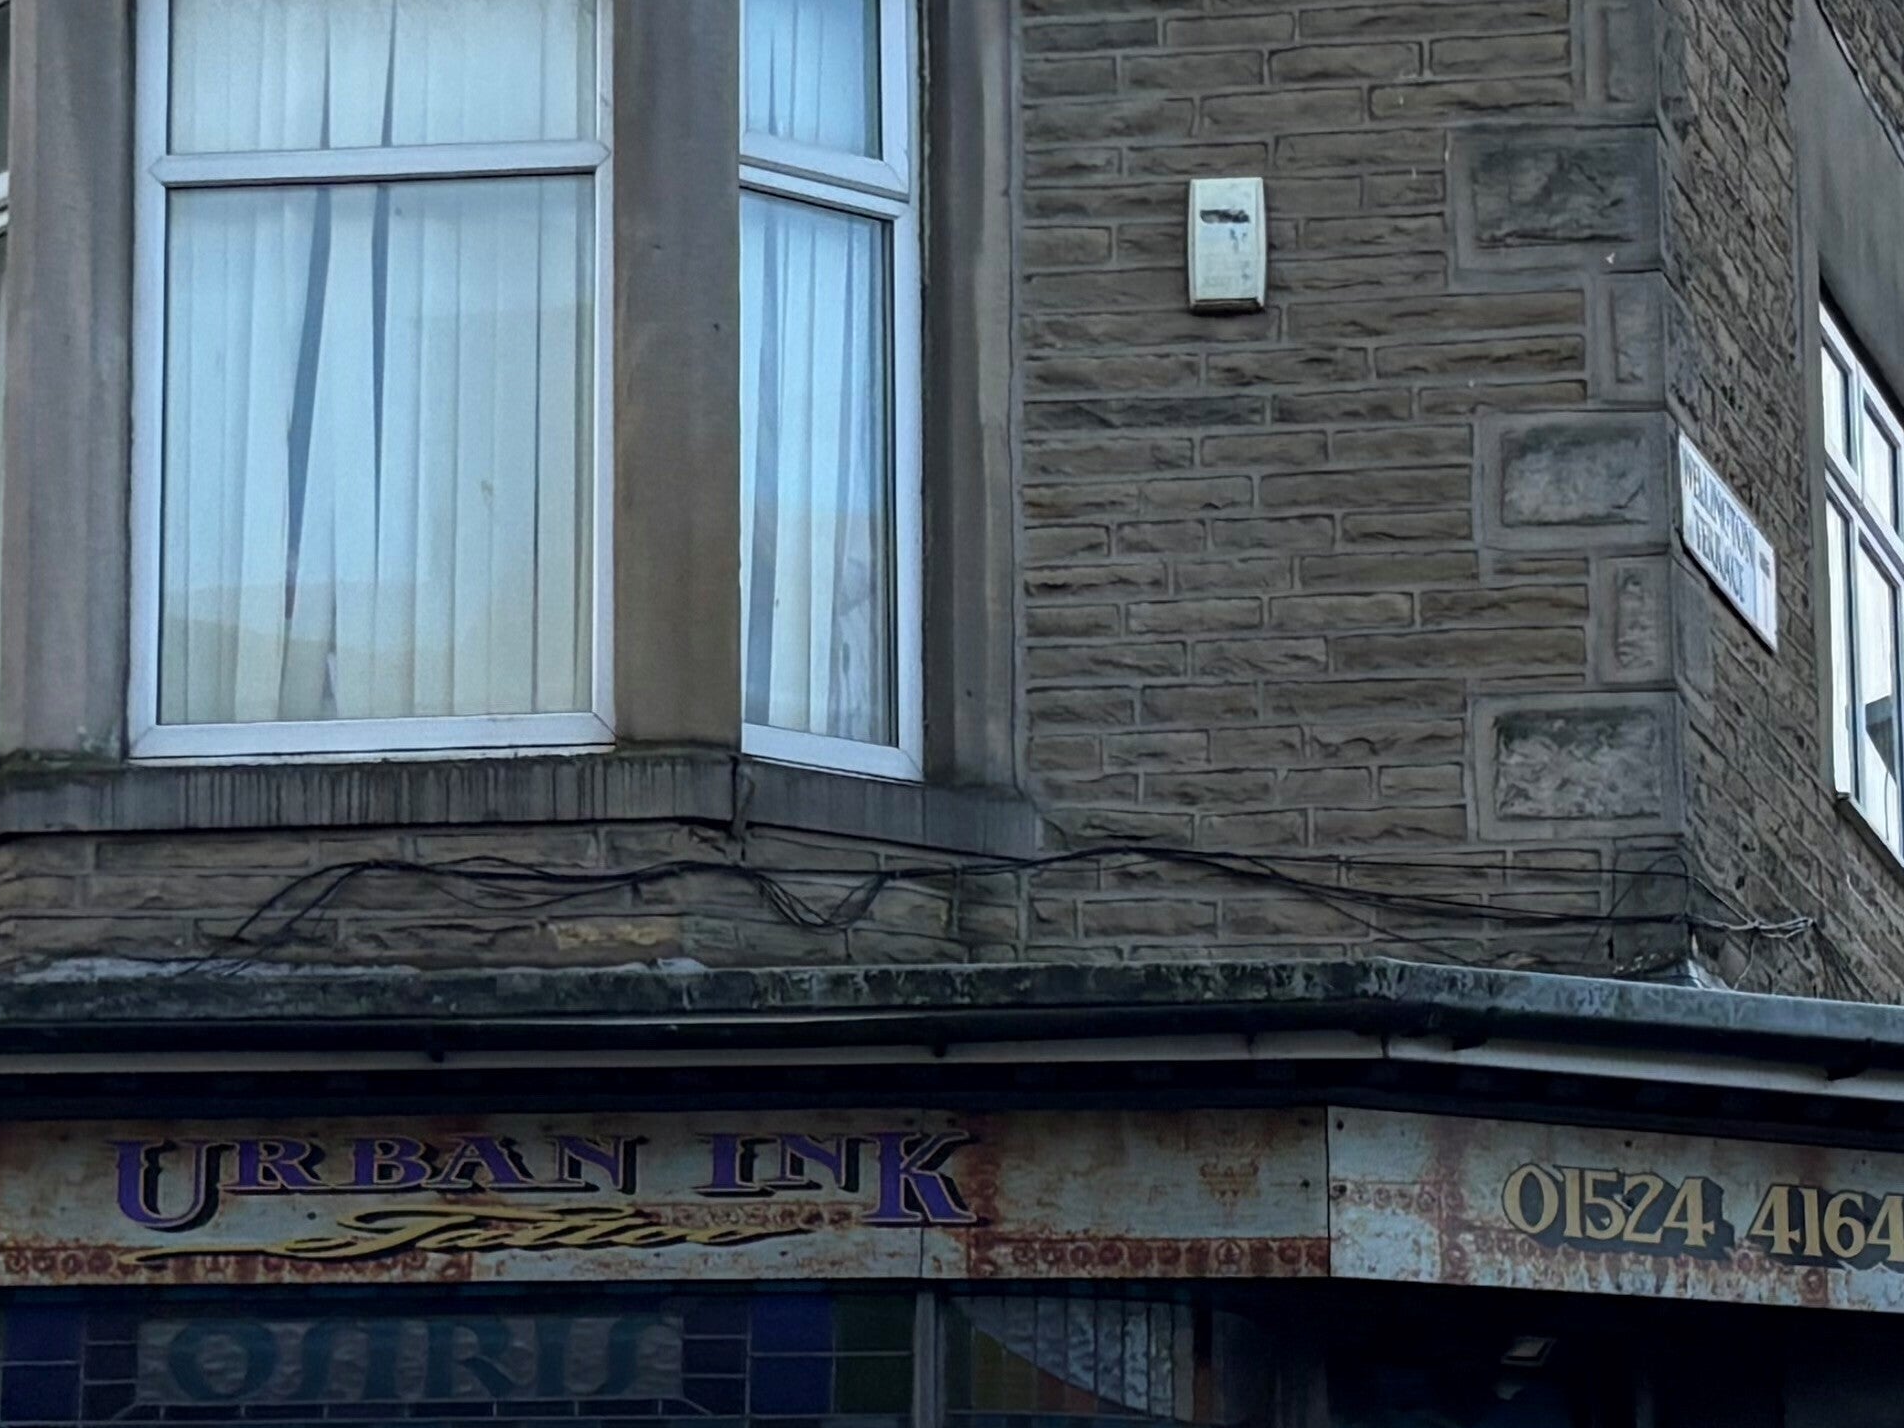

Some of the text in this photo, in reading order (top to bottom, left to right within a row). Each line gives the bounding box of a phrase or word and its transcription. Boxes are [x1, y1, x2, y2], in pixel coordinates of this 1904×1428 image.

[109, 1128, 981, 1233] URBAN INK
[1501, 1160, 1724, 1260] 01524
